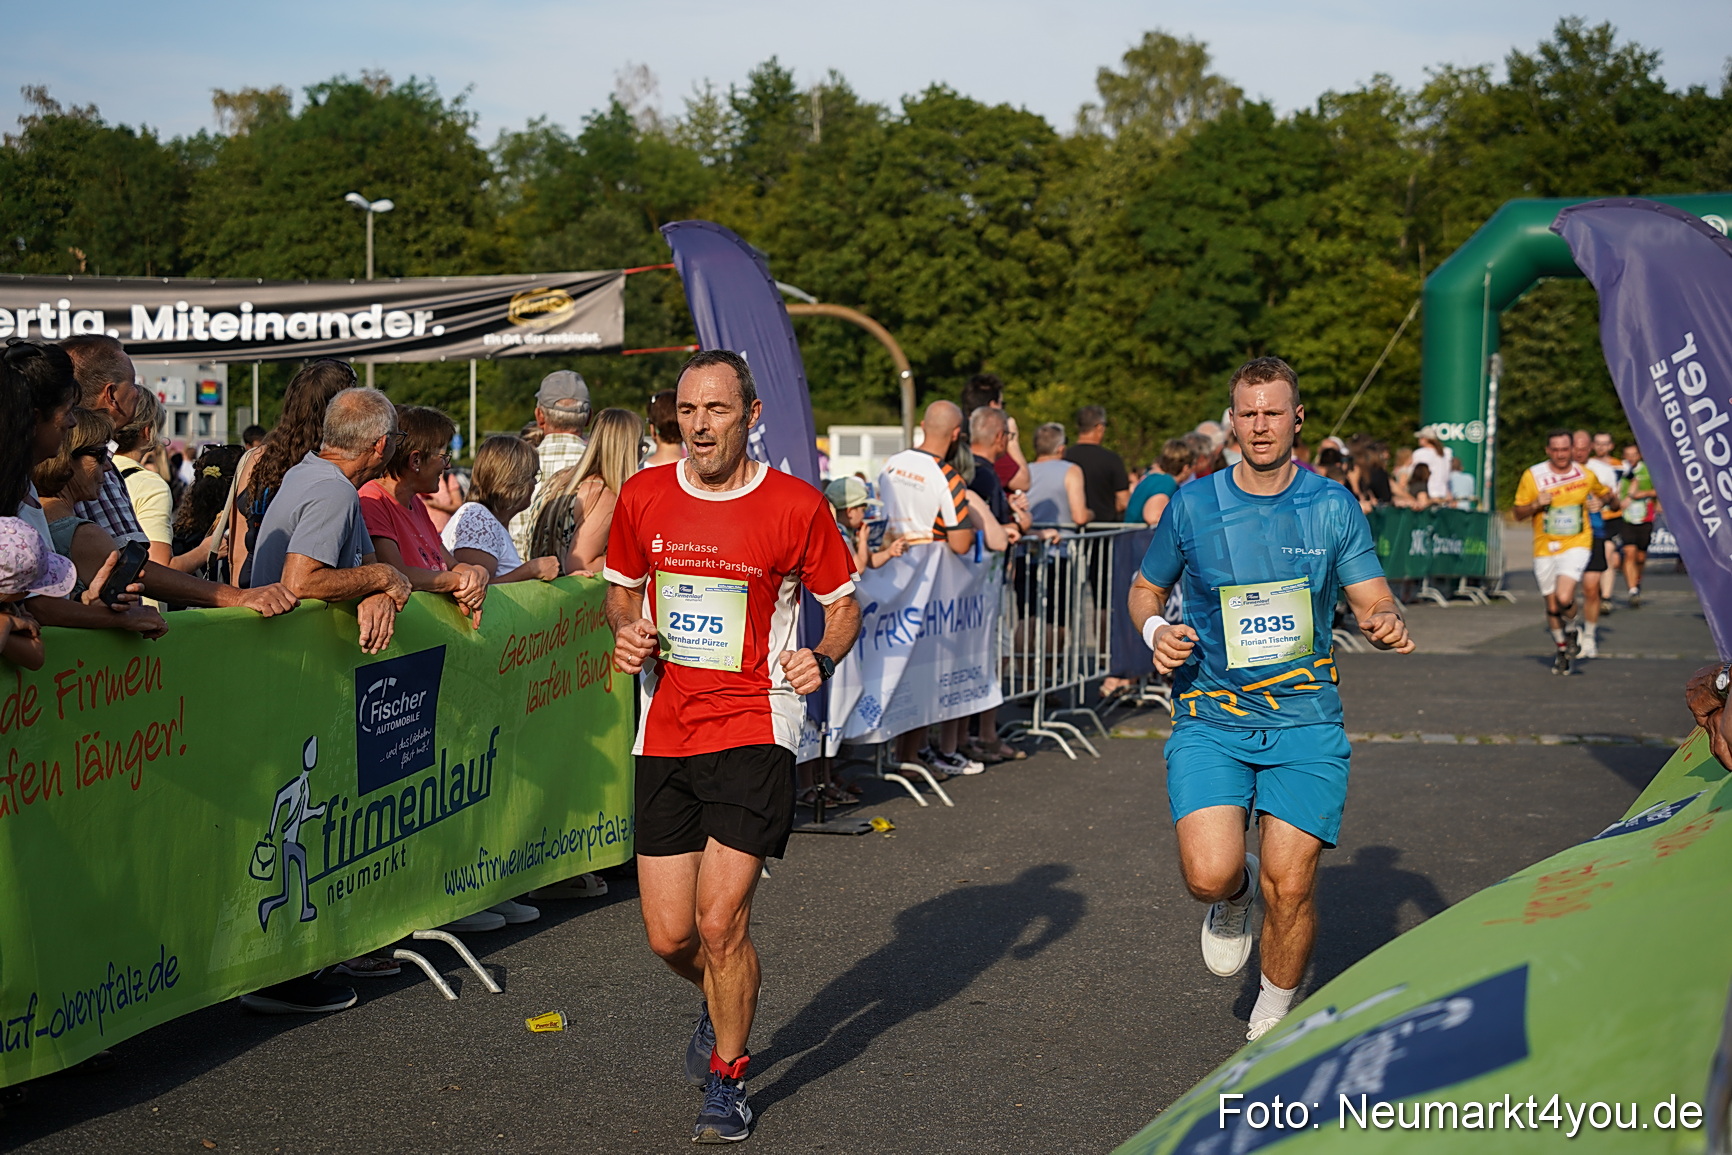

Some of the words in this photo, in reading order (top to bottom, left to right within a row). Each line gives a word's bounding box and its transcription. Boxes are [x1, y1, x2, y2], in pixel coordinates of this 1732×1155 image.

[131, 301, 445, 342] Miteinander.
[1433, 422, 1466, 441] OK
[665, 541, 719, 554] Sparkasse
[1295, 547, 1327, 556] PLAST
[664, 556, 763, 577] Neumarkt-Parsberg
[498, 606, 569, 675] Gesunde
[573, 600, 608, 642] Firme
[669, 611, 723, 634] 2575
[873, 594, 984, 650] FRISCHMANN
[1239, 615, 1295, 635] 2835
[667, 632, 700, 645] Bernhard
[702, 638, 728, 648] Pürzer
[1240, 637, 1267, 647] Florian
[1268, 635, 1301, 645] Tischner
[54, 655, 163, 720] Firmen
[526, 660, 572, 715] laufen
[371, 690, 427, 724] Fischer
[376, 711, 421, 736] AUTOMOBILE
[75, 695, 187, 791] länger!
[322, 726, 500, 872] firmenlauf
[327, 844, 406, 906] neumarkt
[0, 944, 180, 1053] uf-oberpfalz.de
